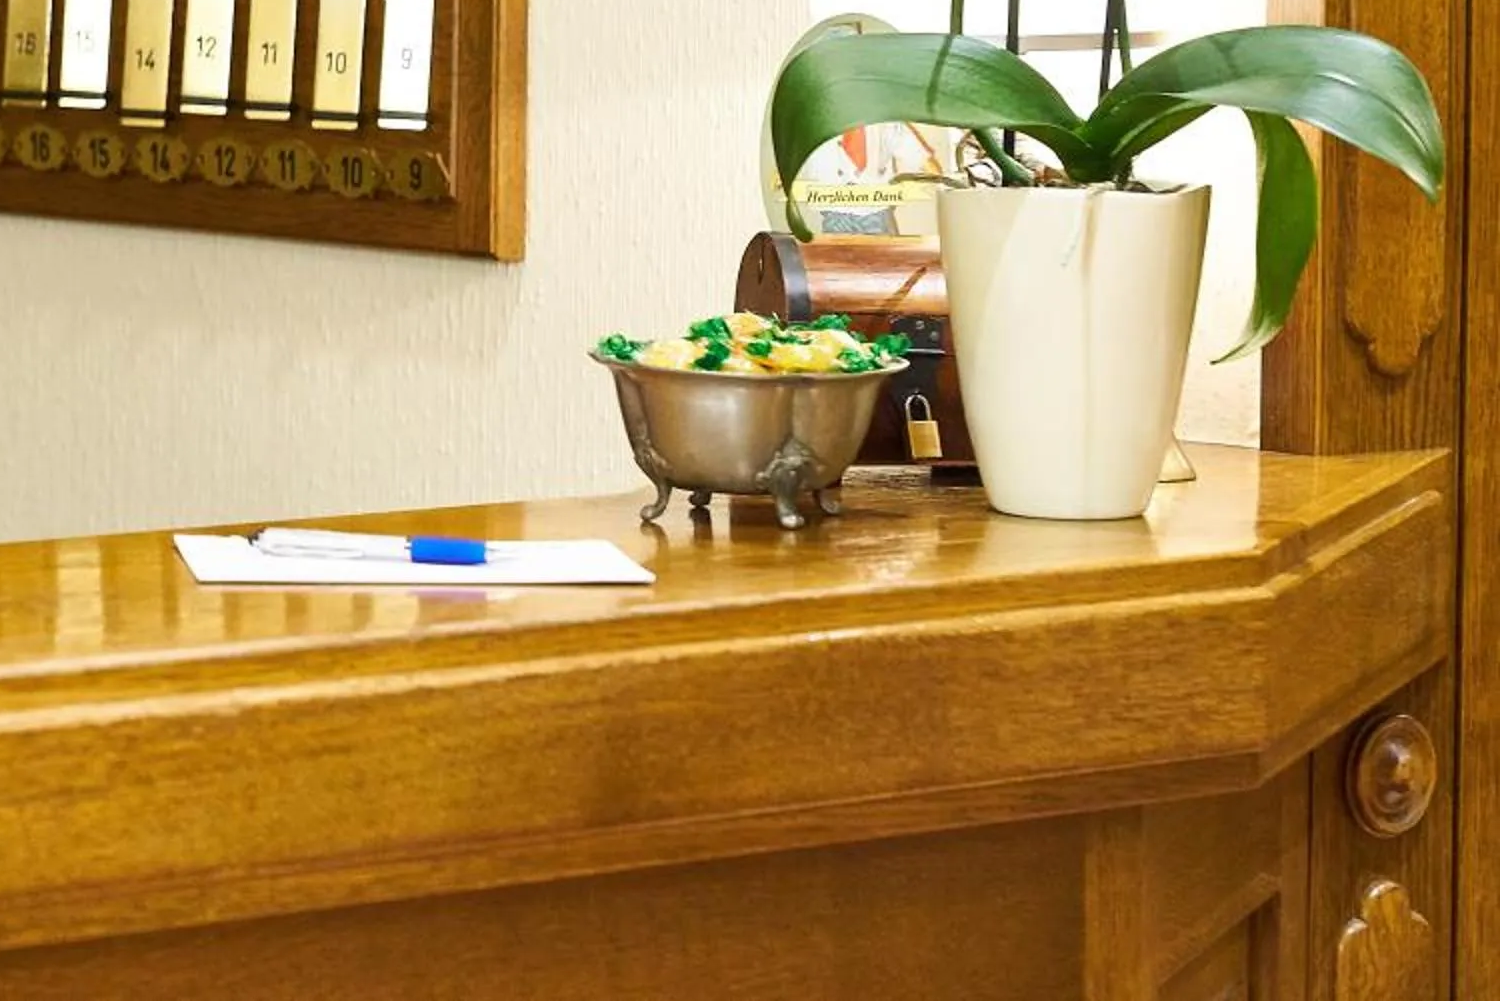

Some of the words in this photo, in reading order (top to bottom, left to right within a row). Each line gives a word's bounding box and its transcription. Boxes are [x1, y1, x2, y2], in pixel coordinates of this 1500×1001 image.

[135, 49, 156, 72] 14
[196, 36, 218, 59] 12
[261, 42, 278, 65] 11
[400, 48, 413, 70] 9
[325, 51, 348, 75] 10
[29, 127, 50, 157] 16
[89, 138, 110, 169] 15
[150, 143, 171, 175] 14
[215, 145, 236, 178] 12
[278, 148, 296, 176] 11
[341, 155, 363, 186] 10
[409, 159, 422, 190] 9
[806, 189, 870, 204] Herzlichen
[872, 189, 904, 203] Dank
